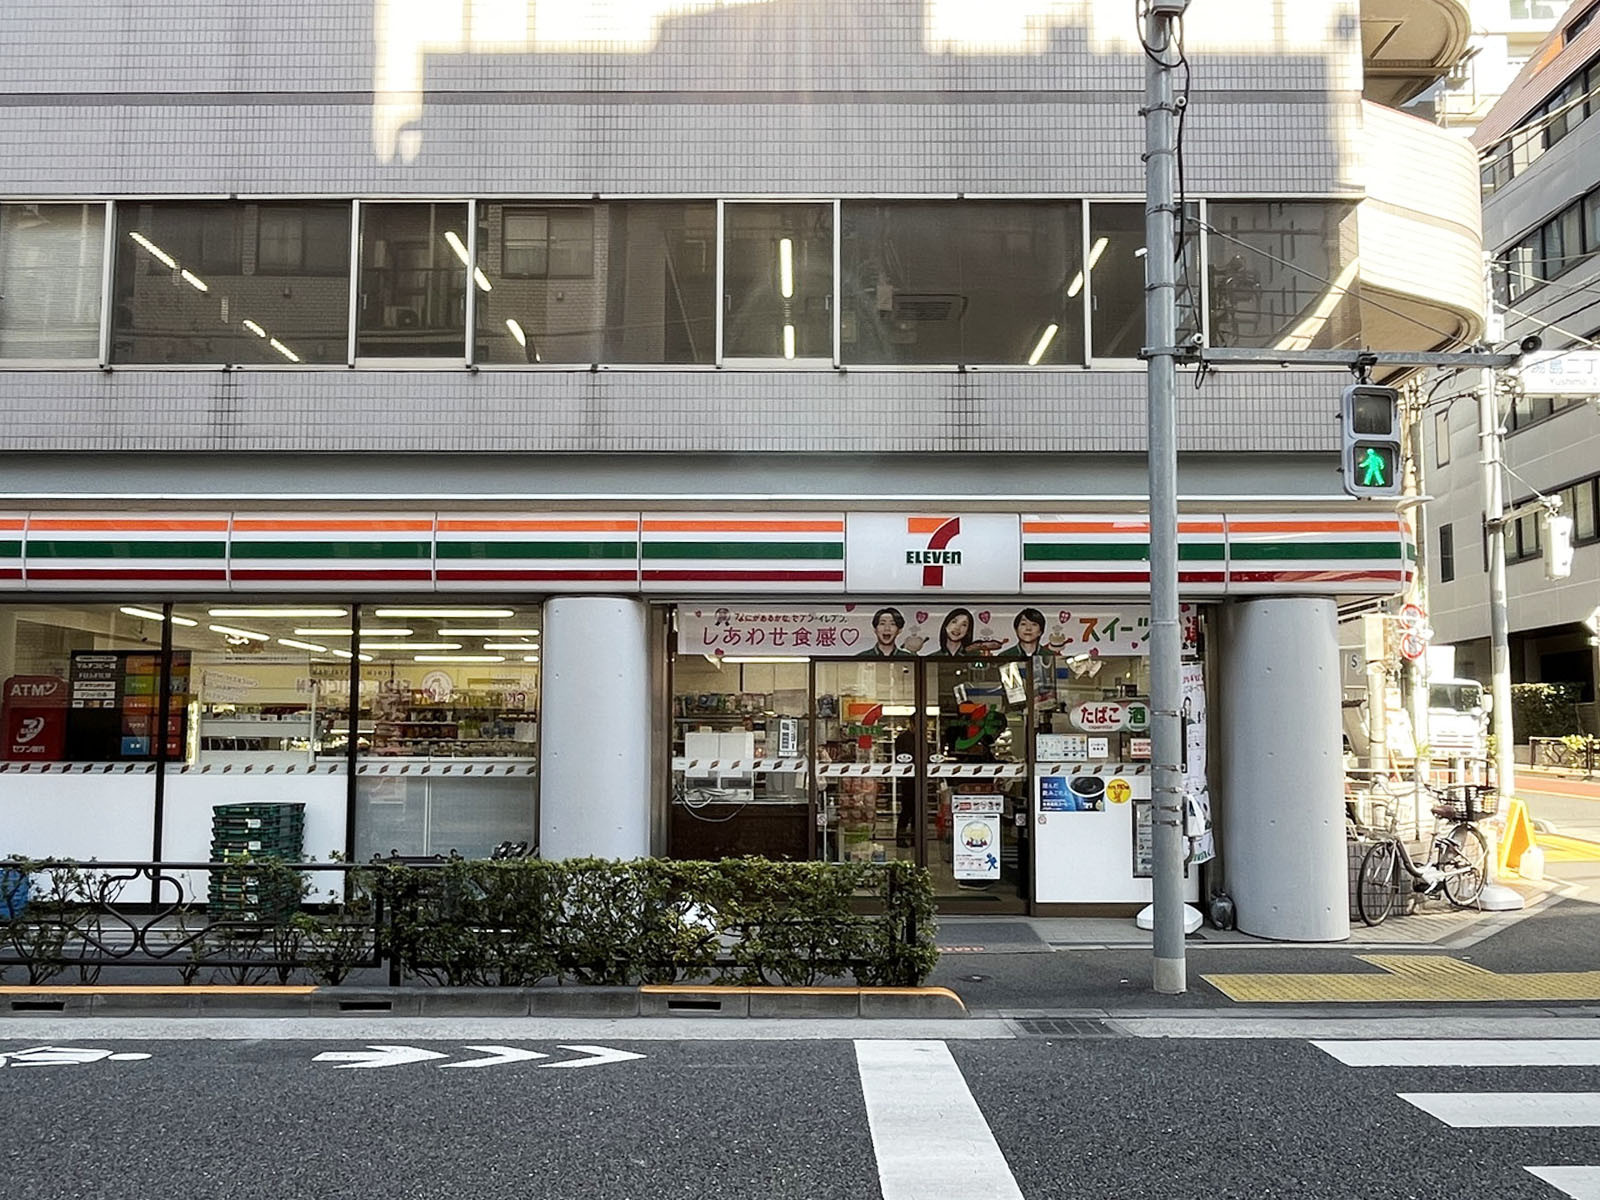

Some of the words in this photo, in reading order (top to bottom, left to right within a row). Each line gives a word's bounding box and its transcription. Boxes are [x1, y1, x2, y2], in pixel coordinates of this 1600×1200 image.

[703, 626, 837, 647] しあわせ食感
[10, 683, 45, 697] ATM
[1081, 706, 1121, 724] たばこ
[1128, 706, 1146, 724] 酒
